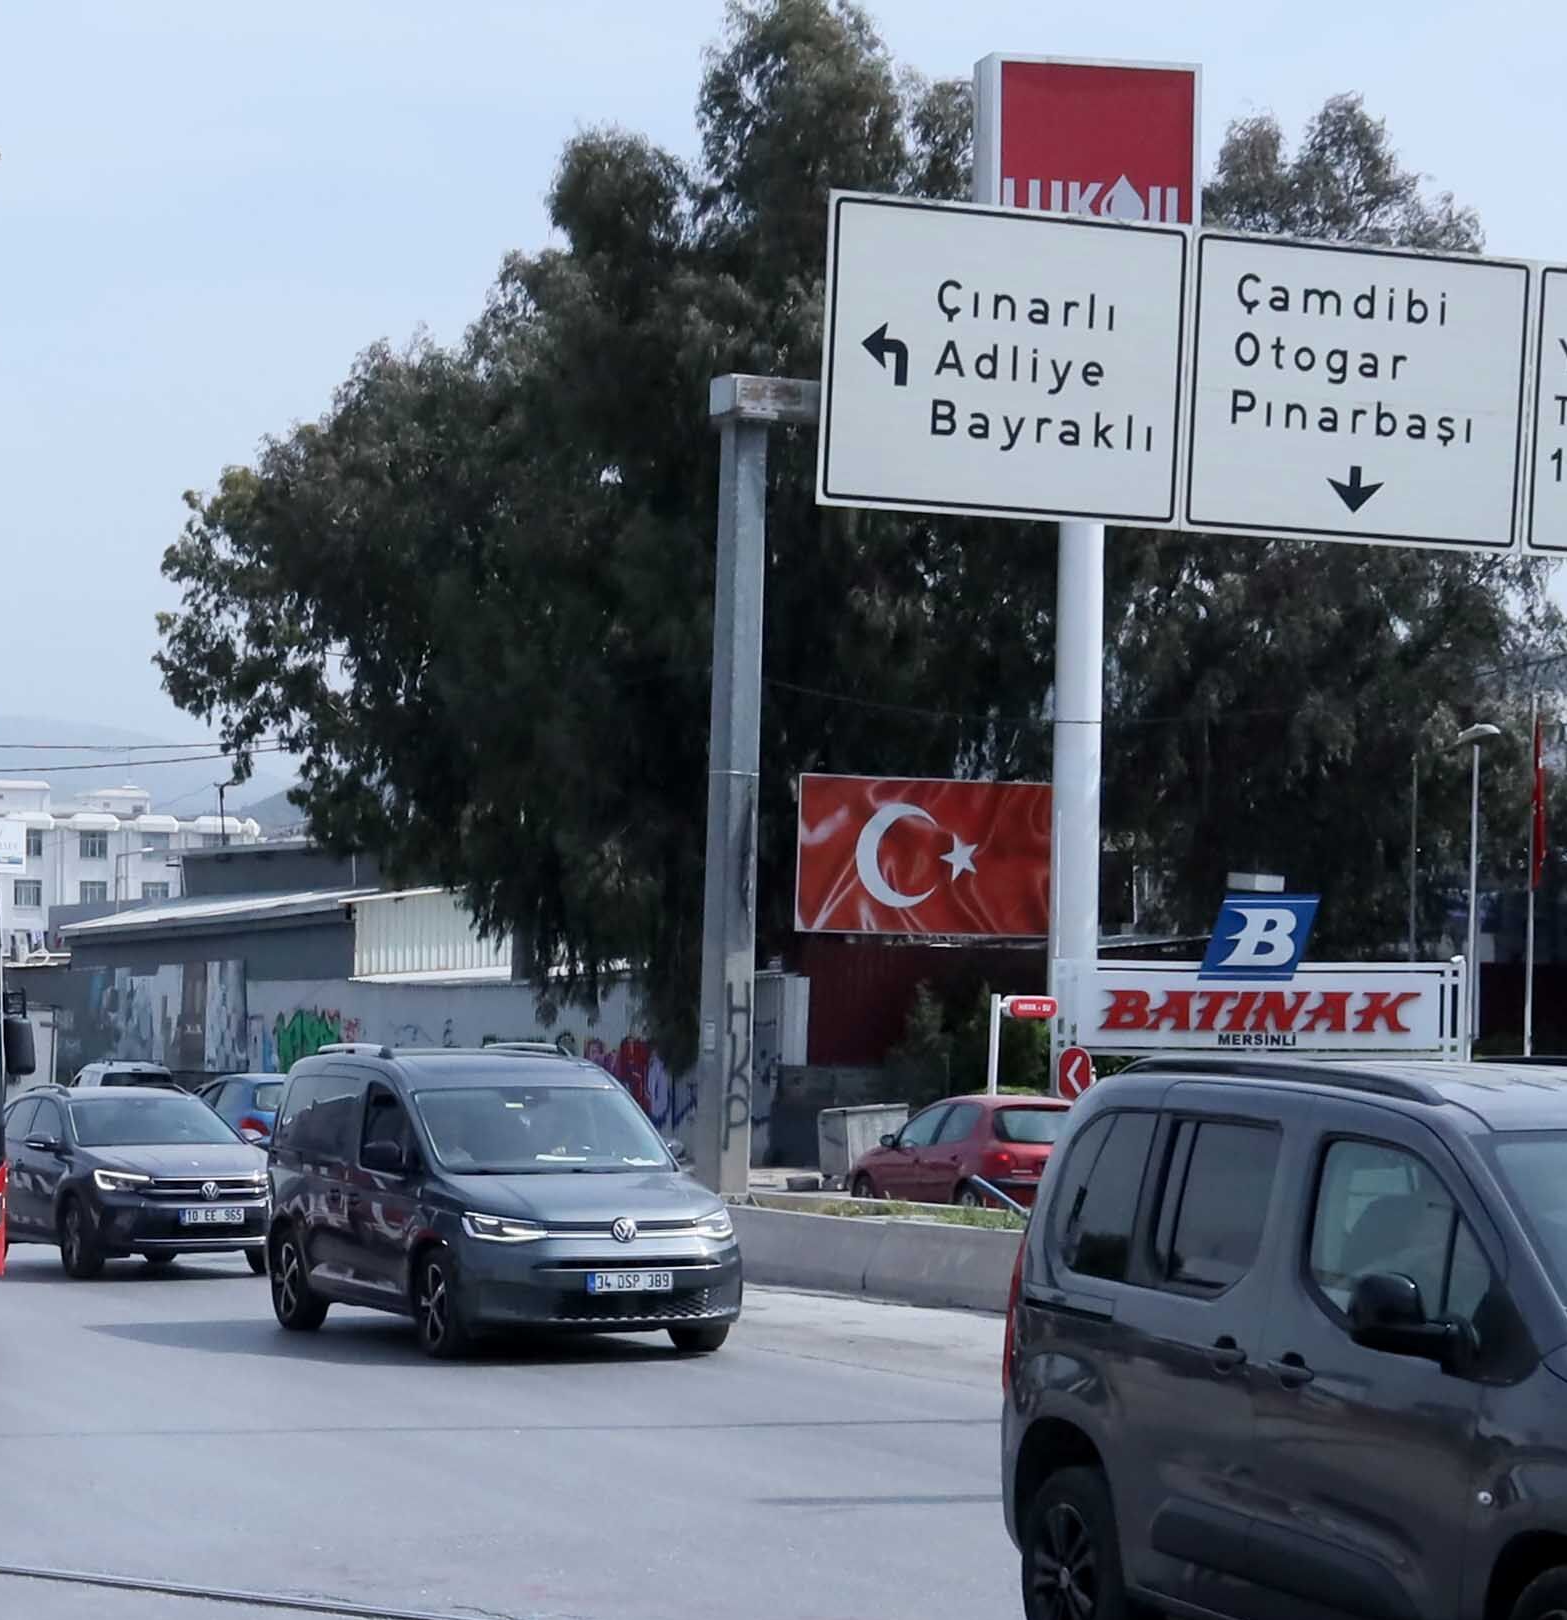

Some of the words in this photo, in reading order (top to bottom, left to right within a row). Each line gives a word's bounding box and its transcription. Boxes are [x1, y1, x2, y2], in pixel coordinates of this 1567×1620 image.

[936, 279, 1115, 331] Çınarlı
[1236, 273, 1447, 326] Çamdibi
[934, 340, 1105, 395] Adliye
[1234, 331, 1408, 385] Otogar
[930, 398, 1153, 452] Bayraklı
[1230, 389, 1472, 447] Pınarbaşı
[1216, 907, 1299, 967] B
[1098, 989, 1423, 1033] BATINAK
[1217, 1031, 1298, 1048] MERSİNLİ
[597, 1275, 612, 1289] 34
